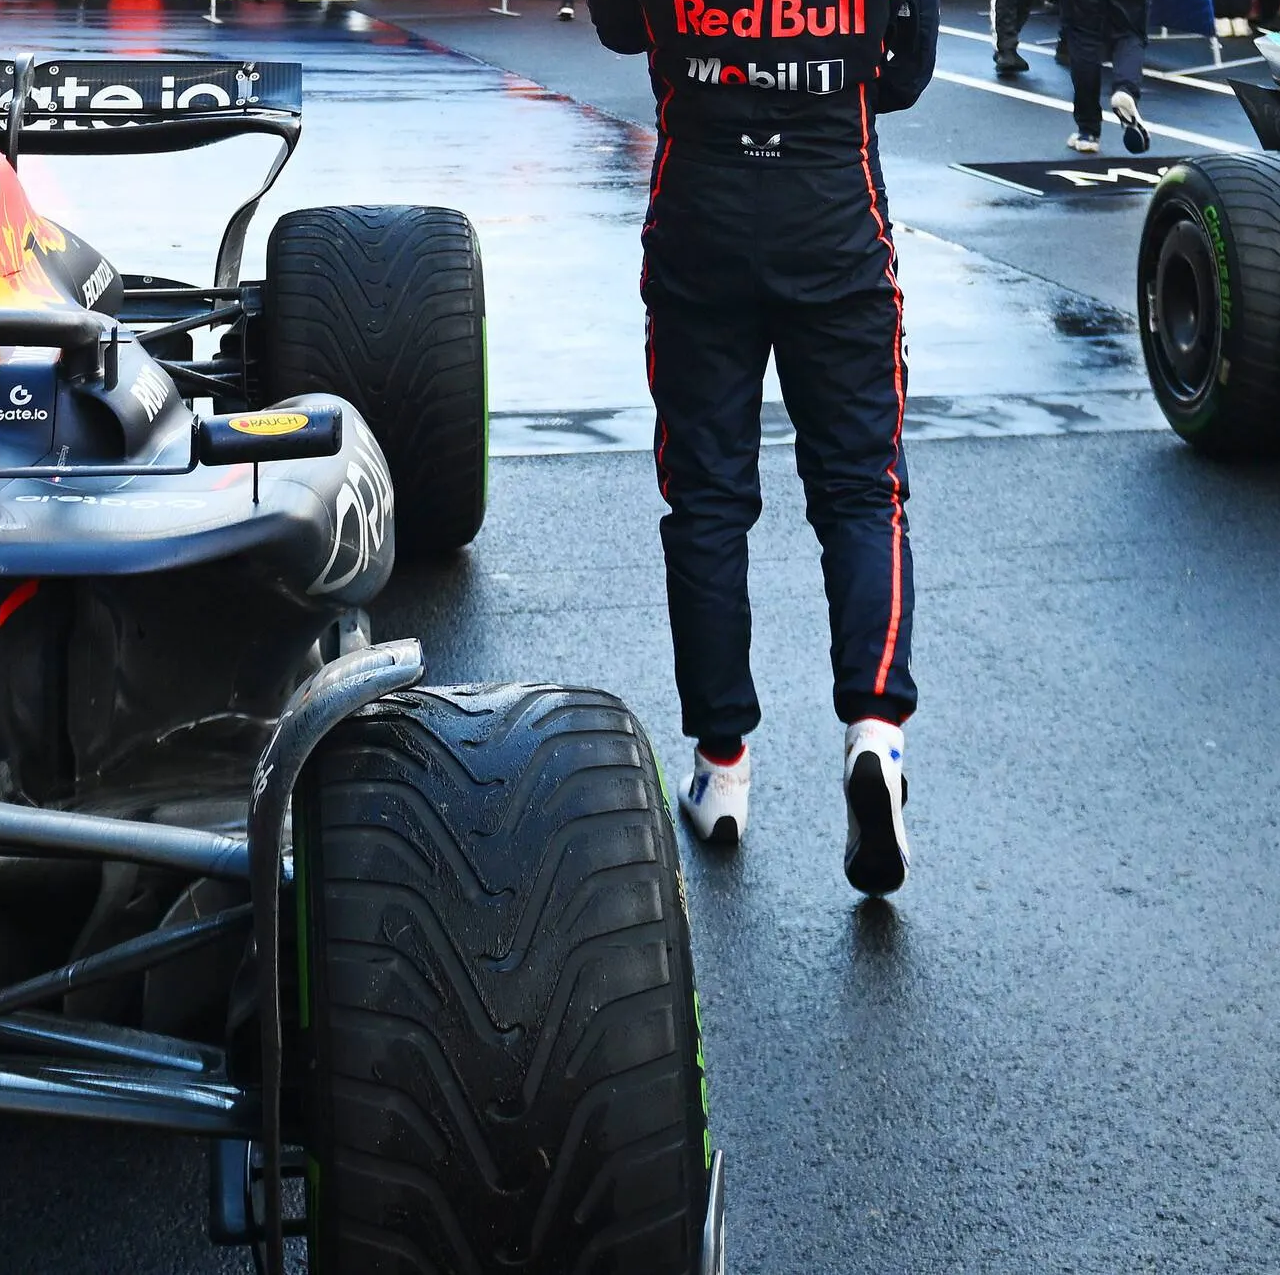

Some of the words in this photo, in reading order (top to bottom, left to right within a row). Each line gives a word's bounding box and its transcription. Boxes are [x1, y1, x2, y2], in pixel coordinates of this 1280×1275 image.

[686, 57, 798, 92] Mobil
[82, 258, 114, 310] HONDA
[251, 416, 298, 427] RAUCH
